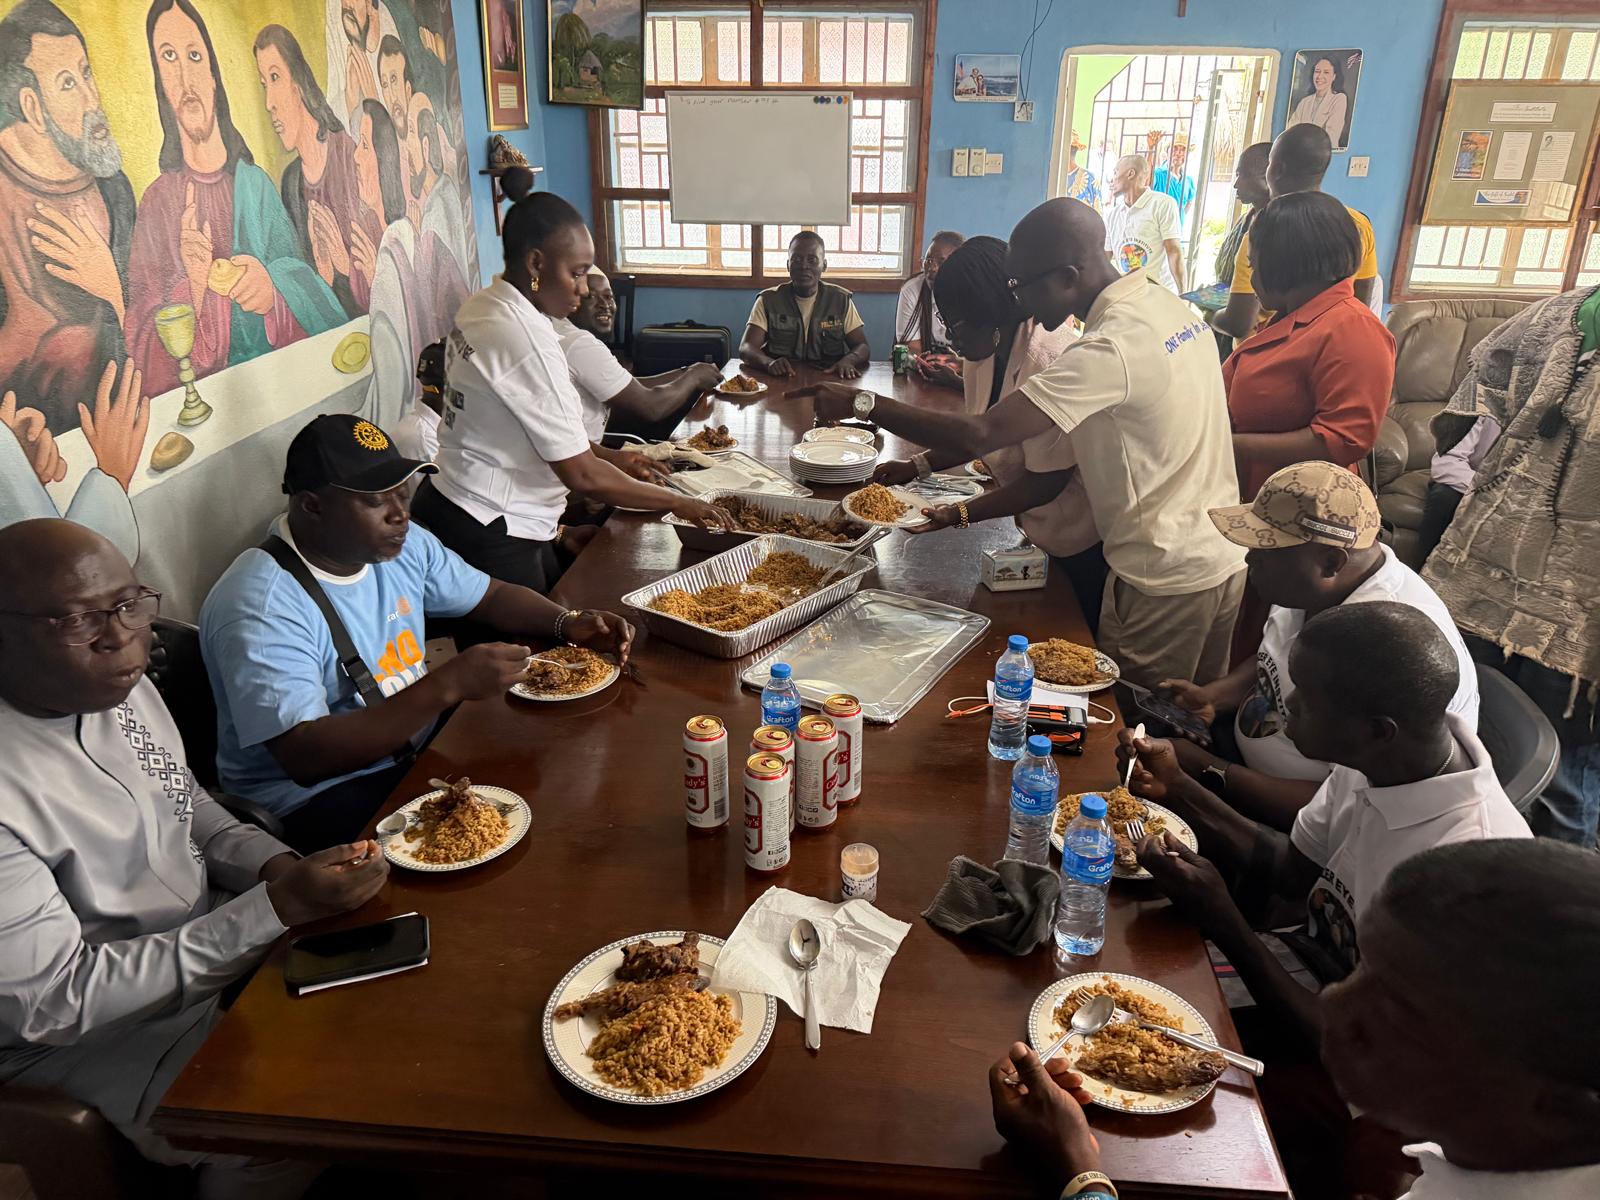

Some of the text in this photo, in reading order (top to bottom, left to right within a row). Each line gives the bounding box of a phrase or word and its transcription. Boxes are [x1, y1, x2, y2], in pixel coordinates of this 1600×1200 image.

[1164, 336, 1180, 354] ONE
[996, 681, 1022, 692] Grafton
[766, 715, 794, 724] Grafton
[1335, 878, 1355, 910] EYE
